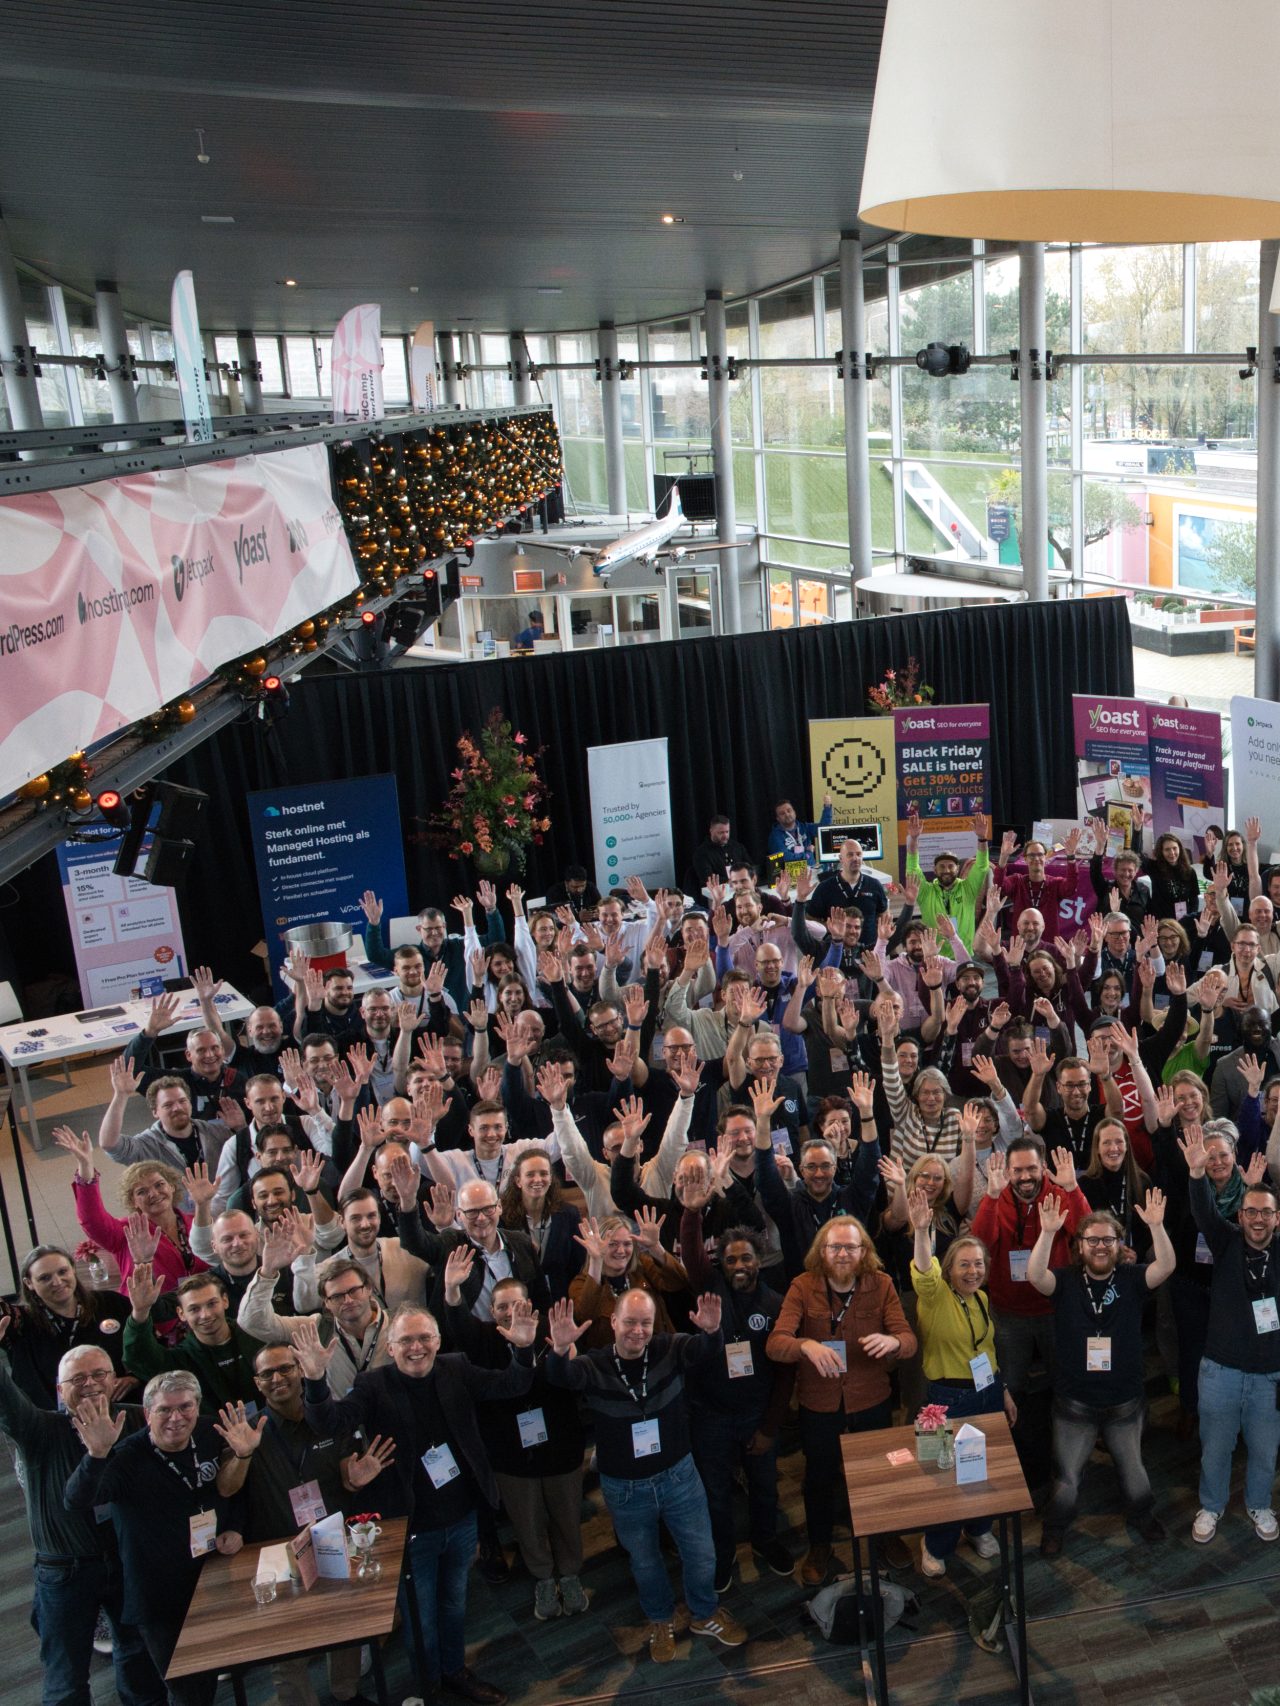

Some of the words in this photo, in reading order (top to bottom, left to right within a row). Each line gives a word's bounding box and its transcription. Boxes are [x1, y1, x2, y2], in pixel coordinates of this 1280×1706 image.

[0, 613, 64, 656] rdPress.com
[1248, 736, 1264, 749] Add
[902, 746, 938, 758] Black
[942, 745, 982, 758] Friday
[1155, 746, 1171, 754] Track
[1172, 749, 1187, 757] your
[1188, 751, 1206, 760] brand
[1248, 750, 1263, 761] you
[903, 762, 933, 773] SALE
[936, 761, 946, 771] is
[950, 760, 983, 771] here!
[1183, 760, 1215, 771] platforms!
[904, 775, 927, 786] Get
[930, 774, 956, 785] 30%
[960, 773, 983, 783] OFF
[904, 787, 933, 797] Yoast
[936, 785, 984, 795] Products
[282, 801, 325, 816] hostnet
[603, 803, 630, 814] Trusted
[631, 802, 640, 810] by
[833, 807, 855, 815] Next
[859, 805, 878, 814] level
[603, 814, 633, 824] 50,000+
[635, 809, 666, 820] Agencies
[852, 815, 891, 824] products
[265, 828, 292, 840] Sterk
[294, 824, 325, 836] online
[327, 820, 346, 830] met
[267, 841, 314, 853] Managed
[316, 833, 354, 846] Hosting
[356, 830, 370, 840] als
[268, 851, 326, 867] fundament.
[74, 866, 109, 877] 3-month
[77, 884, 94, 892] 15%
[1210, 1044, 1232, 1053] press
